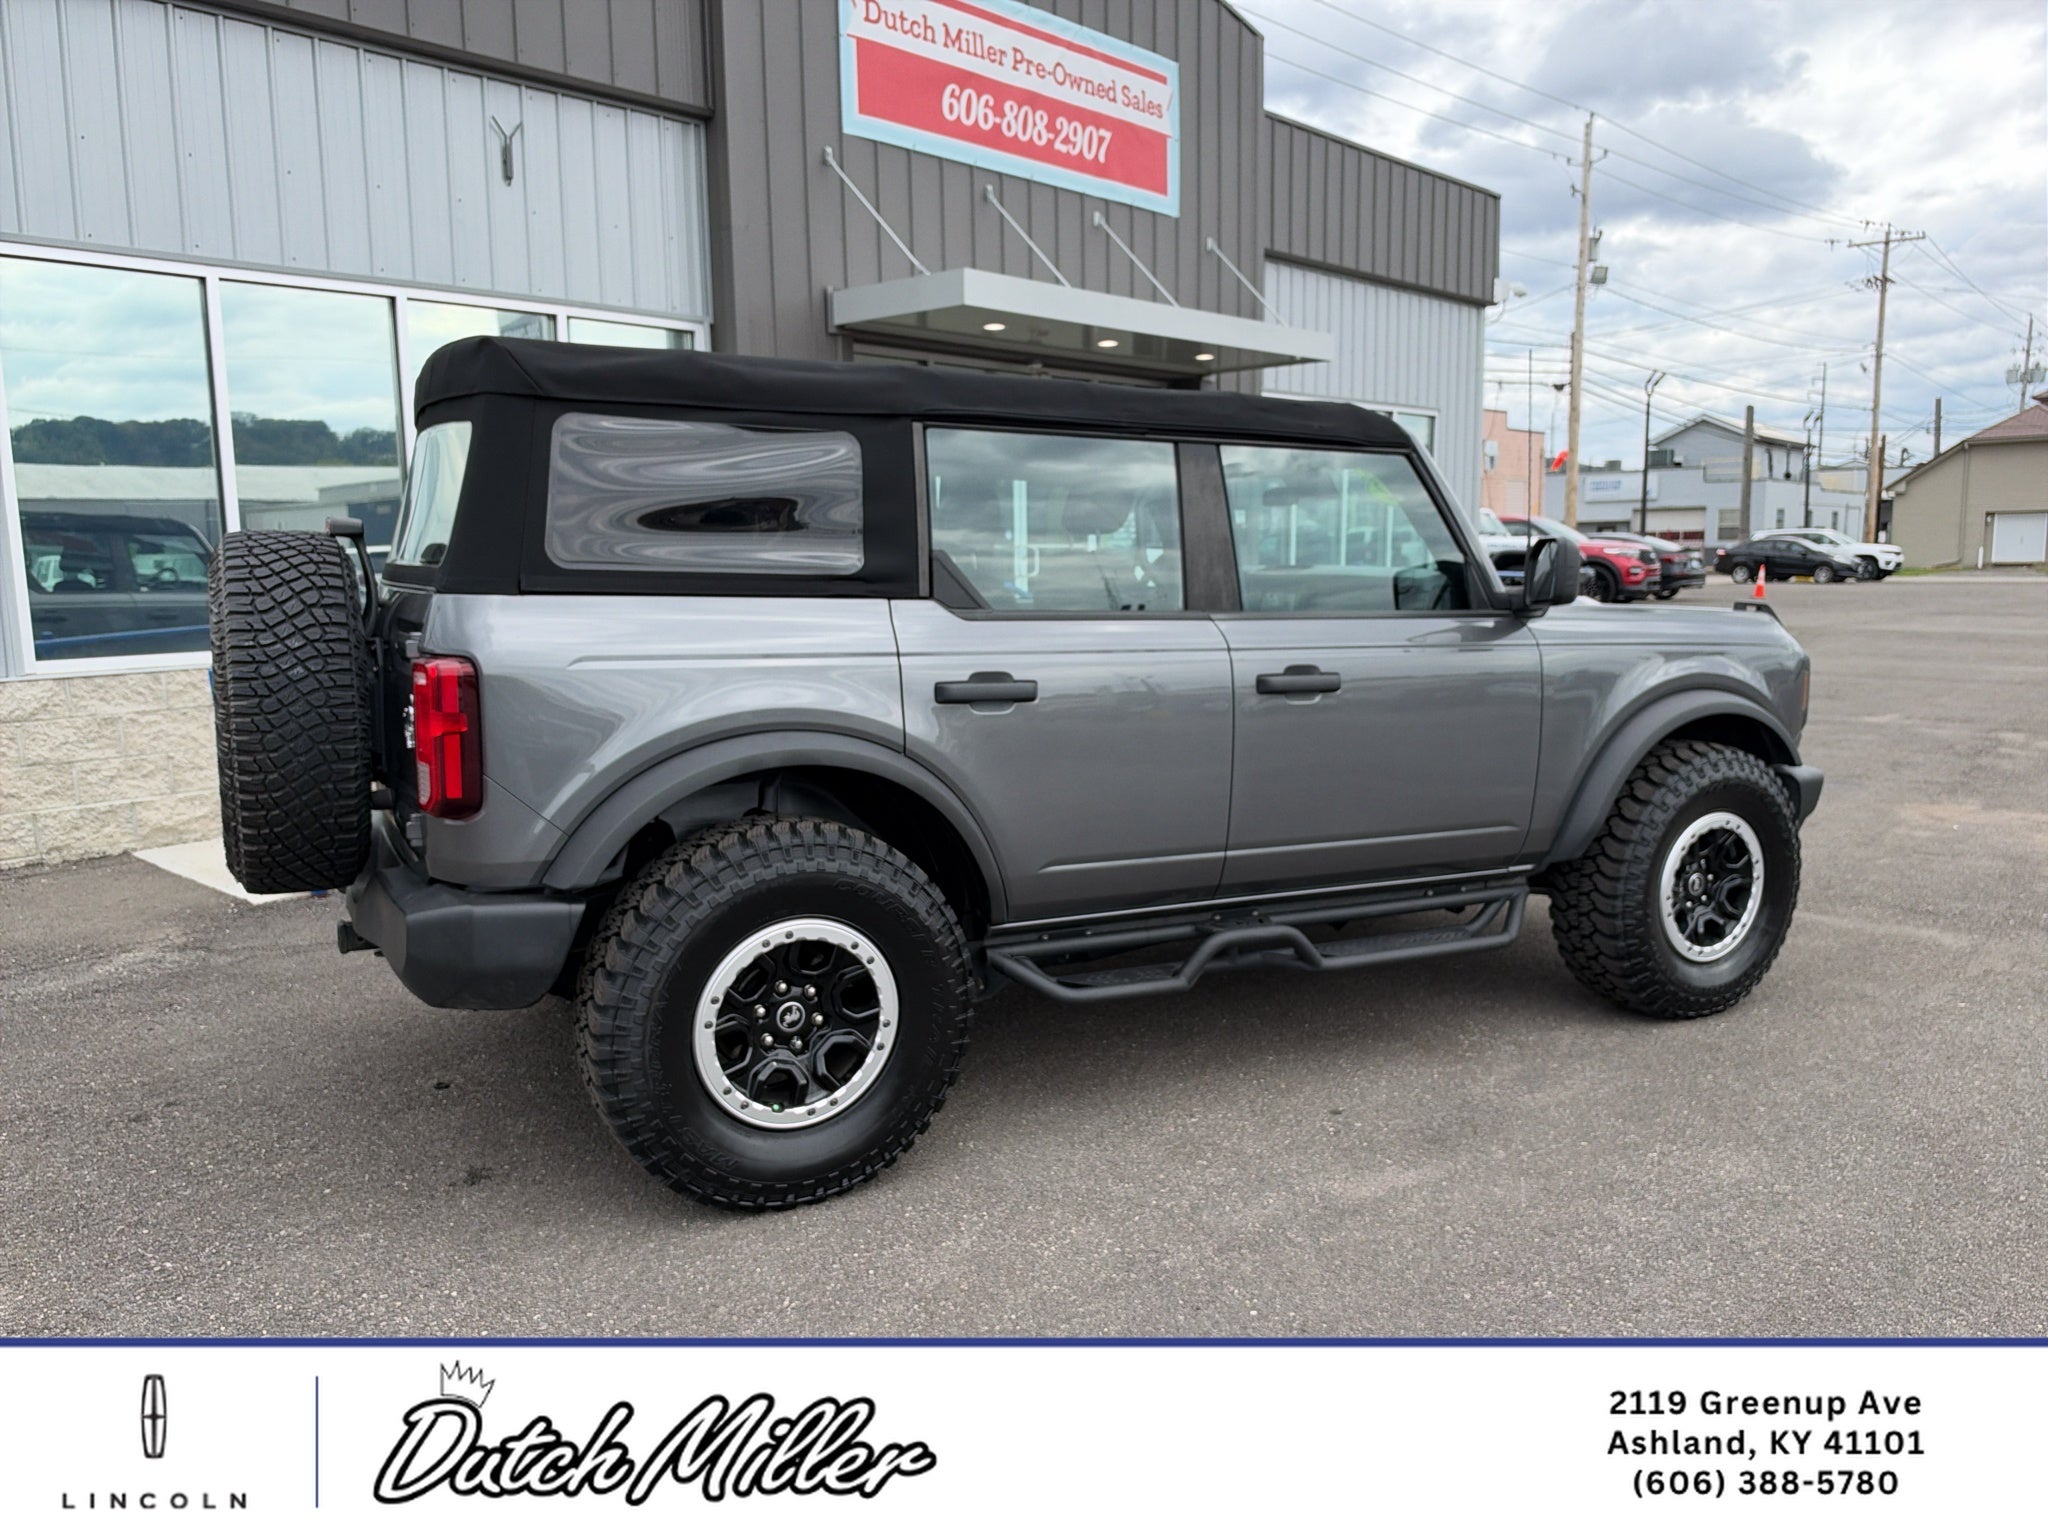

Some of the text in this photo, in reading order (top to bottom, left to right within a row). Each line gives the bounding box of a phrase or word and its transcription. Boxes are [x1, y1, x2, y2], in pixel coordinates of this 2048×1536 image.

[863, 0, 1164, 119] Dutch Miller Pre-Owned Sales
[941, 83, 1113, 164] 606-808-2907
